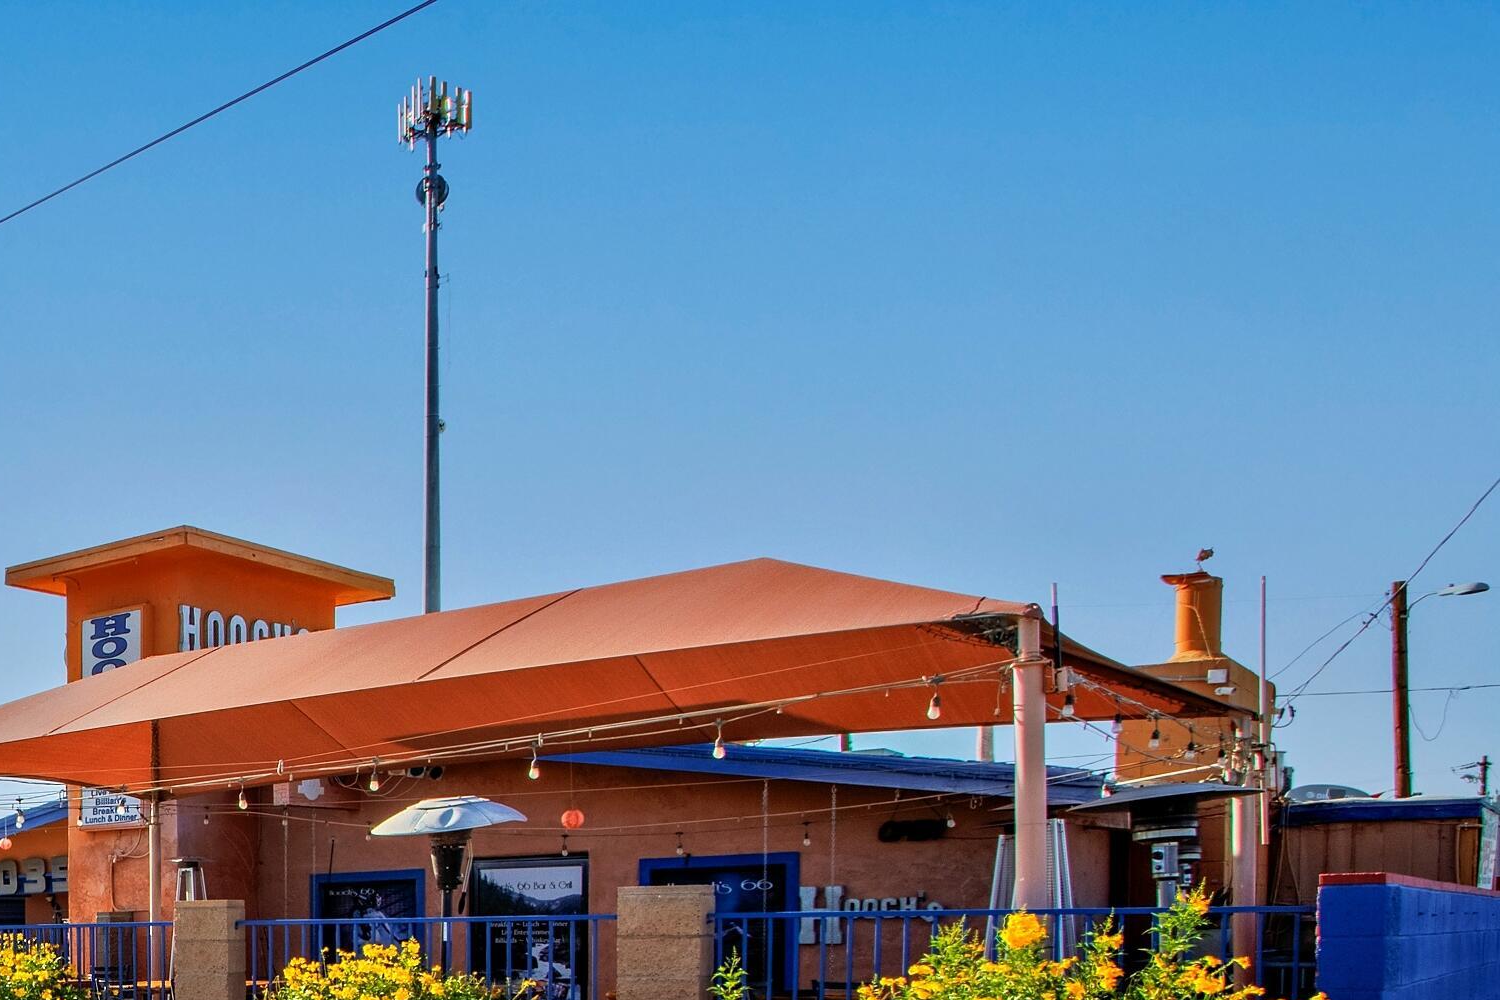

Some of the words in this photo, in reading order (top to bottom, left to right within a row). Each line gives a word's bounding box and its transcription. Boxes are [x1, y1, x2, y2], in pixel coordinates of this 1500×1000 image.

[92, 805, 130, 815] Breakft
[85, 815, 106, 824] Lunch
[108, 815, 113, 823] &
[114, 813, 137, 821] Dinner
[740, 879, 774, 891] 66
